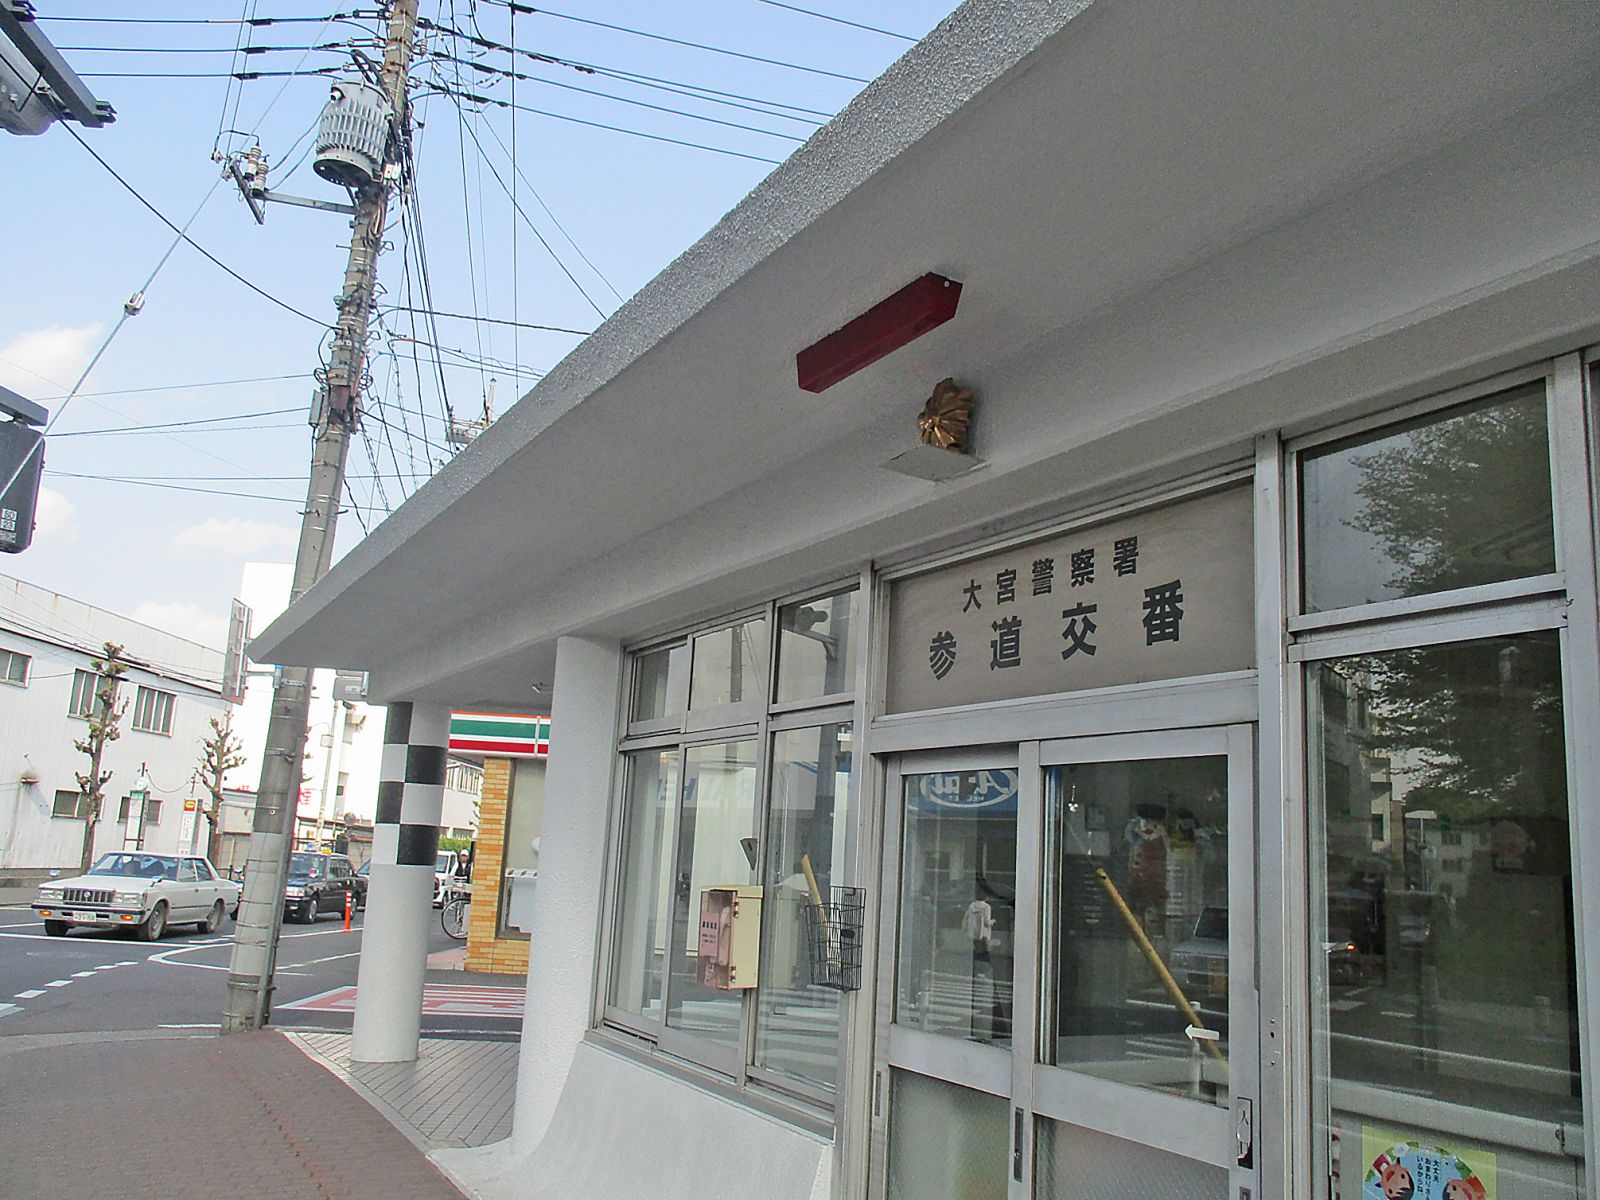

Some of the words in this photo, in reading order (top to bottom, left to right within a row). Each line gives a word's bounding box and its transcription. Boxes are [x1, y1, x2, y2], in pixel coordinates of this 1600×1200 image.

[962, 535, 1139, 613] 大宮警察署
[929, 578, 1184, 681] 参道交番
